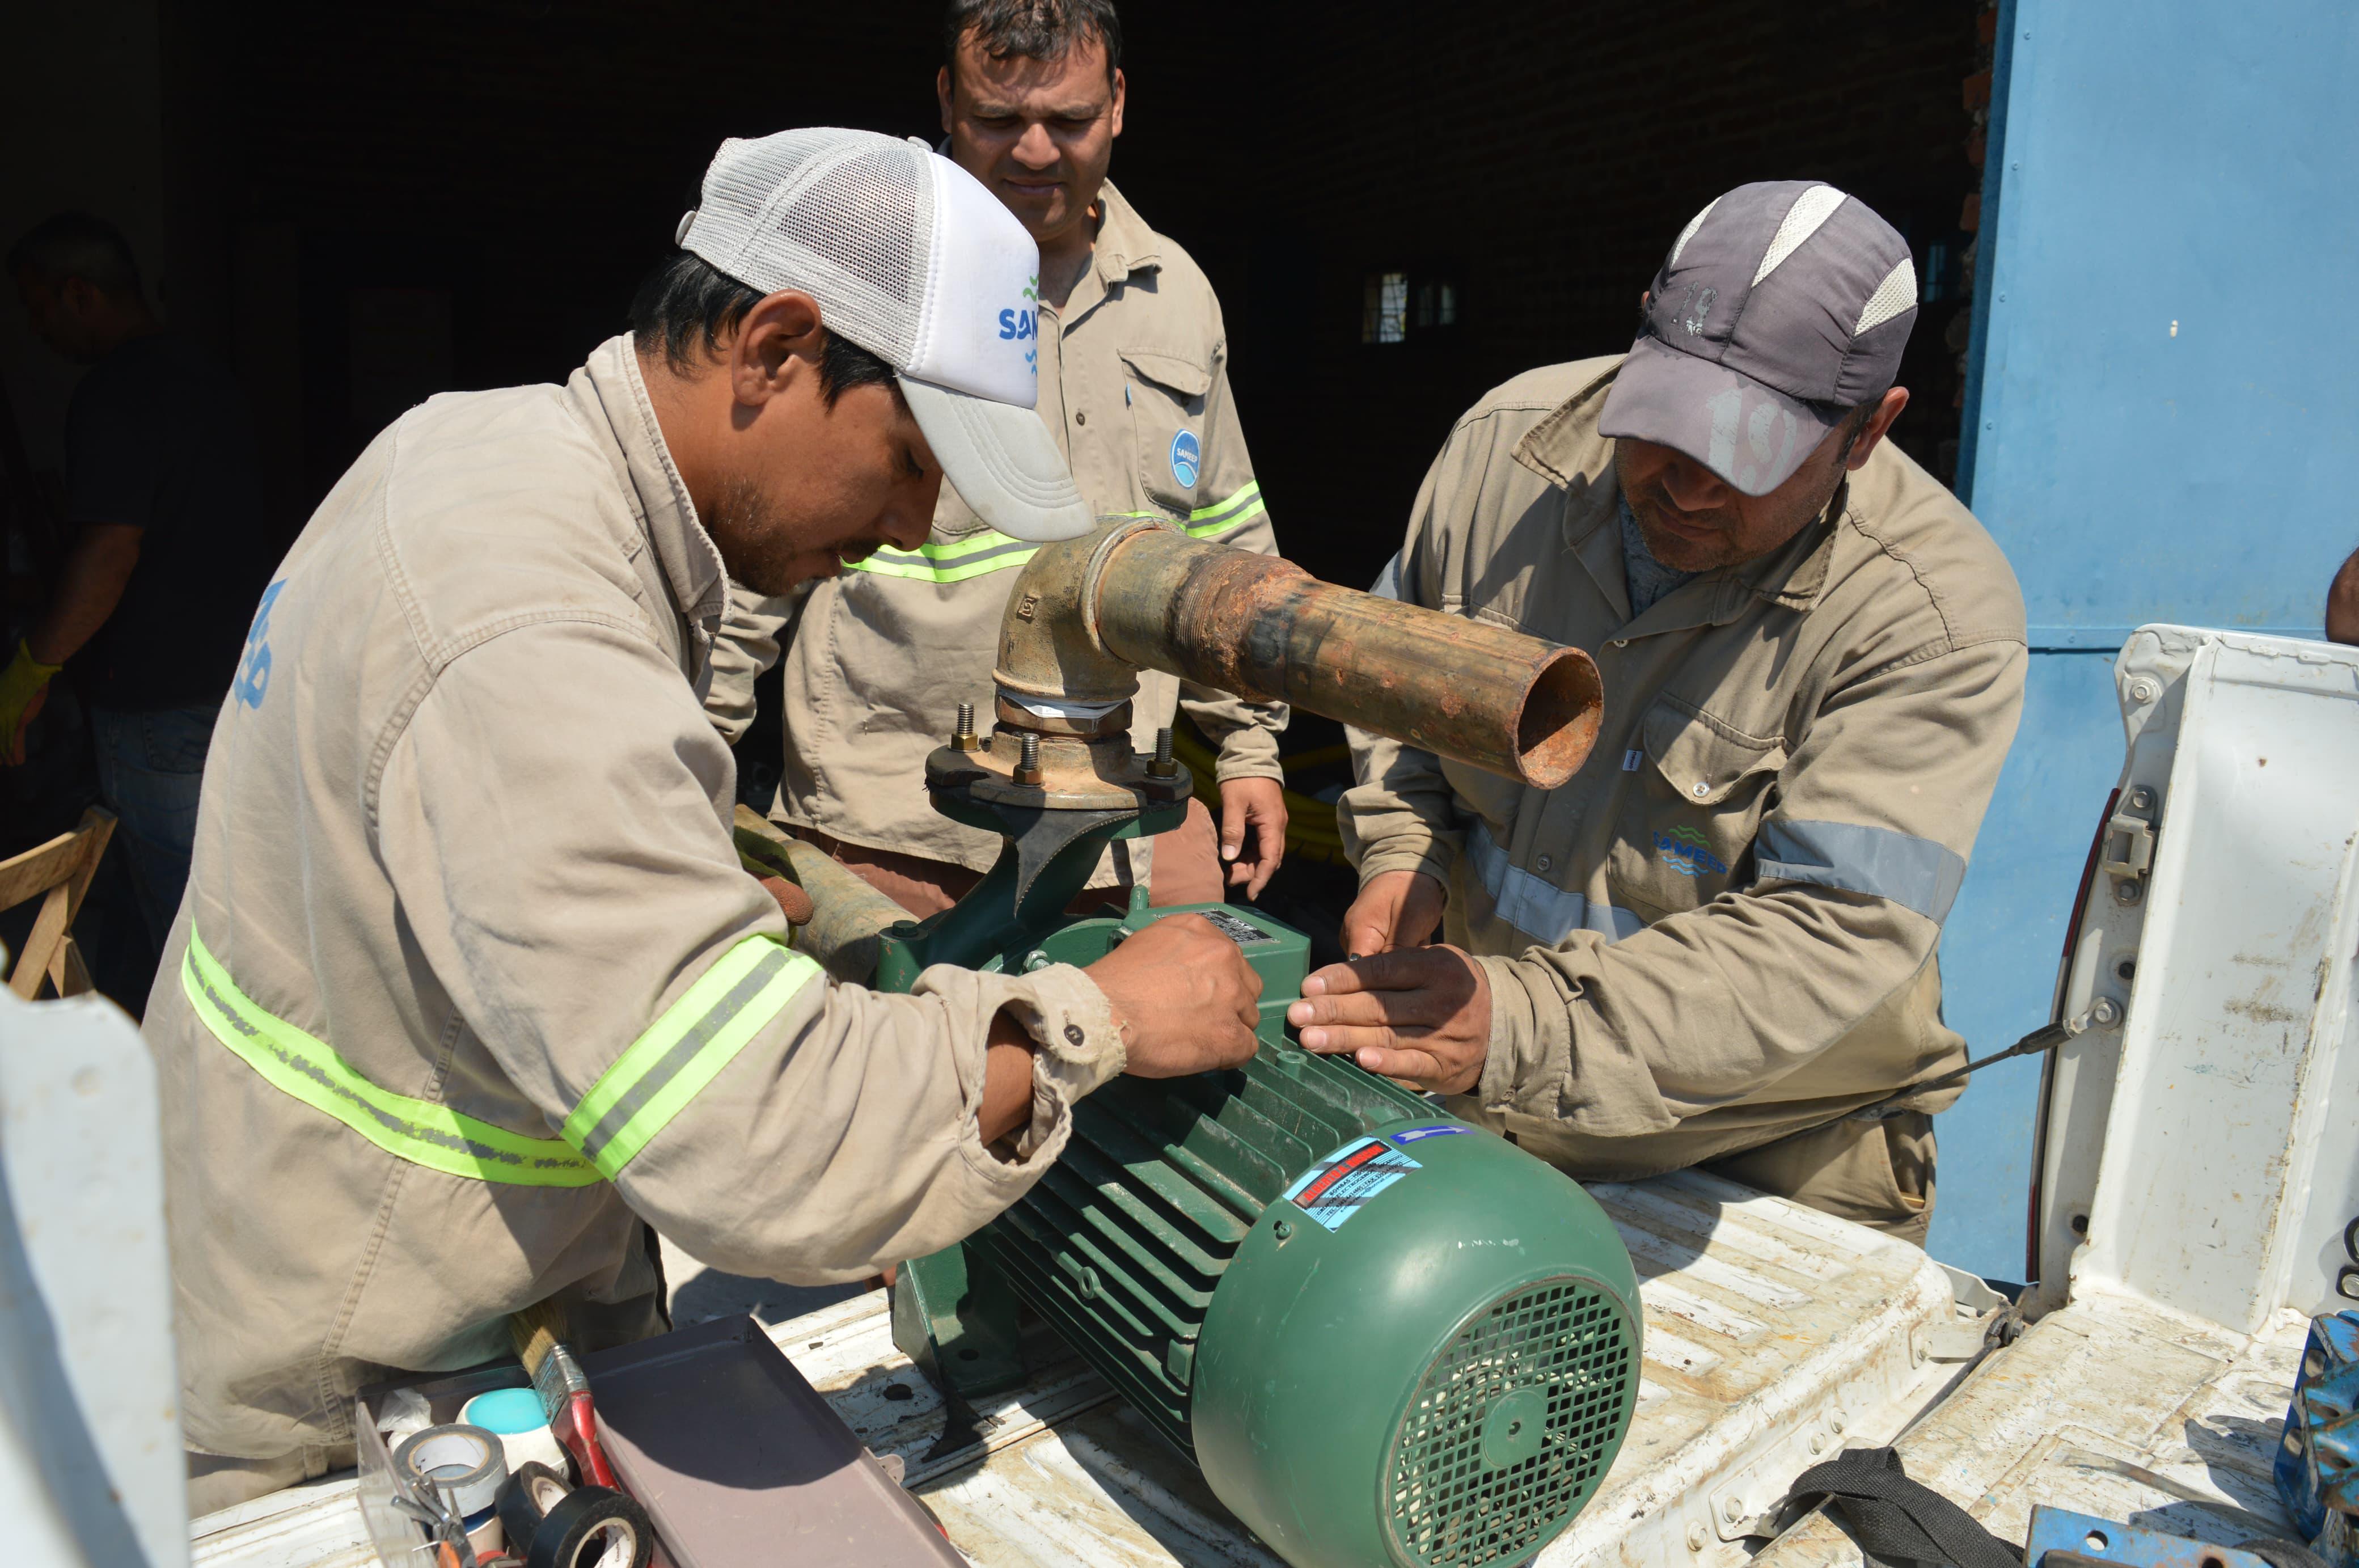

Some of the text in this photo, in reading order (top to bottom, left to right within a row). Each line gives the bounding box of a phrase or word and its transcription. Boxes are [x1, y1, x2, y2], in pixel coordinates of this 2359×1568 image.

[1177, 448, 1198, 463] SAMEEP
[1653, 830, 1727, 874] SAMEEP
[1301, 1169, 1343, 1201] ALBERTO
[1328, 1178, 1351, 1195] BOMBAS
[1316, 1197, 1337, 1215] GRUPOS
